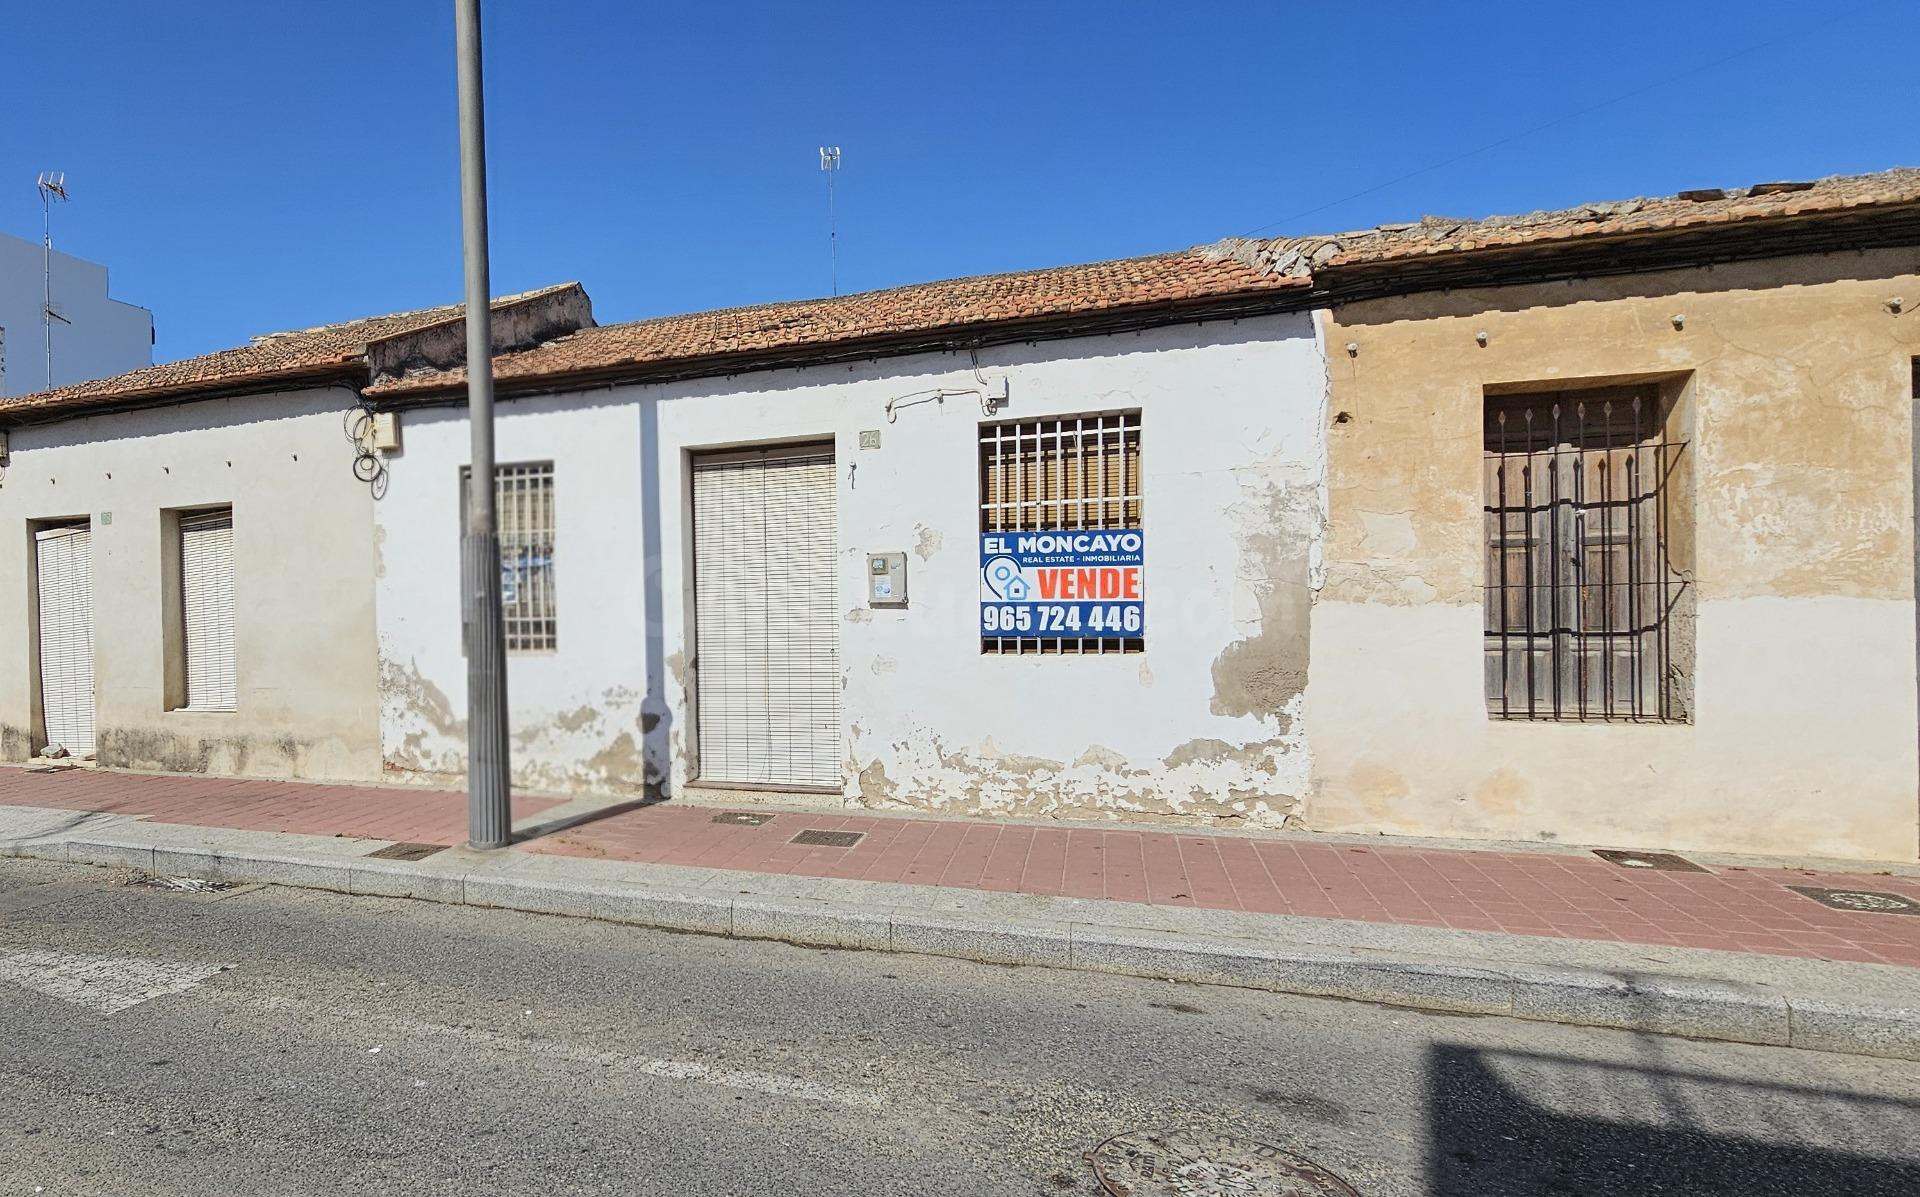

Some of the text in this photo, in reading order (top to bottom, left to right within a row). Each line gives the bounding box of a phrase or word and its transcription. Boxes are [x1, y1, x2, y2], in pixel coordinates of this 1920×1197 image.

[984, 533, 1142, 554] EL MONCAYO
[1045, 555, 1075, 563] ESTATE
[1082, 554, 1141, 562] INMOBILIARIA
[1037, 568, 1139, 600] VENDE
[983, 605, 1031, 631] 965
[1037, 605, 1082, 631] 724
[1088, 605, 1141, 631] 446
